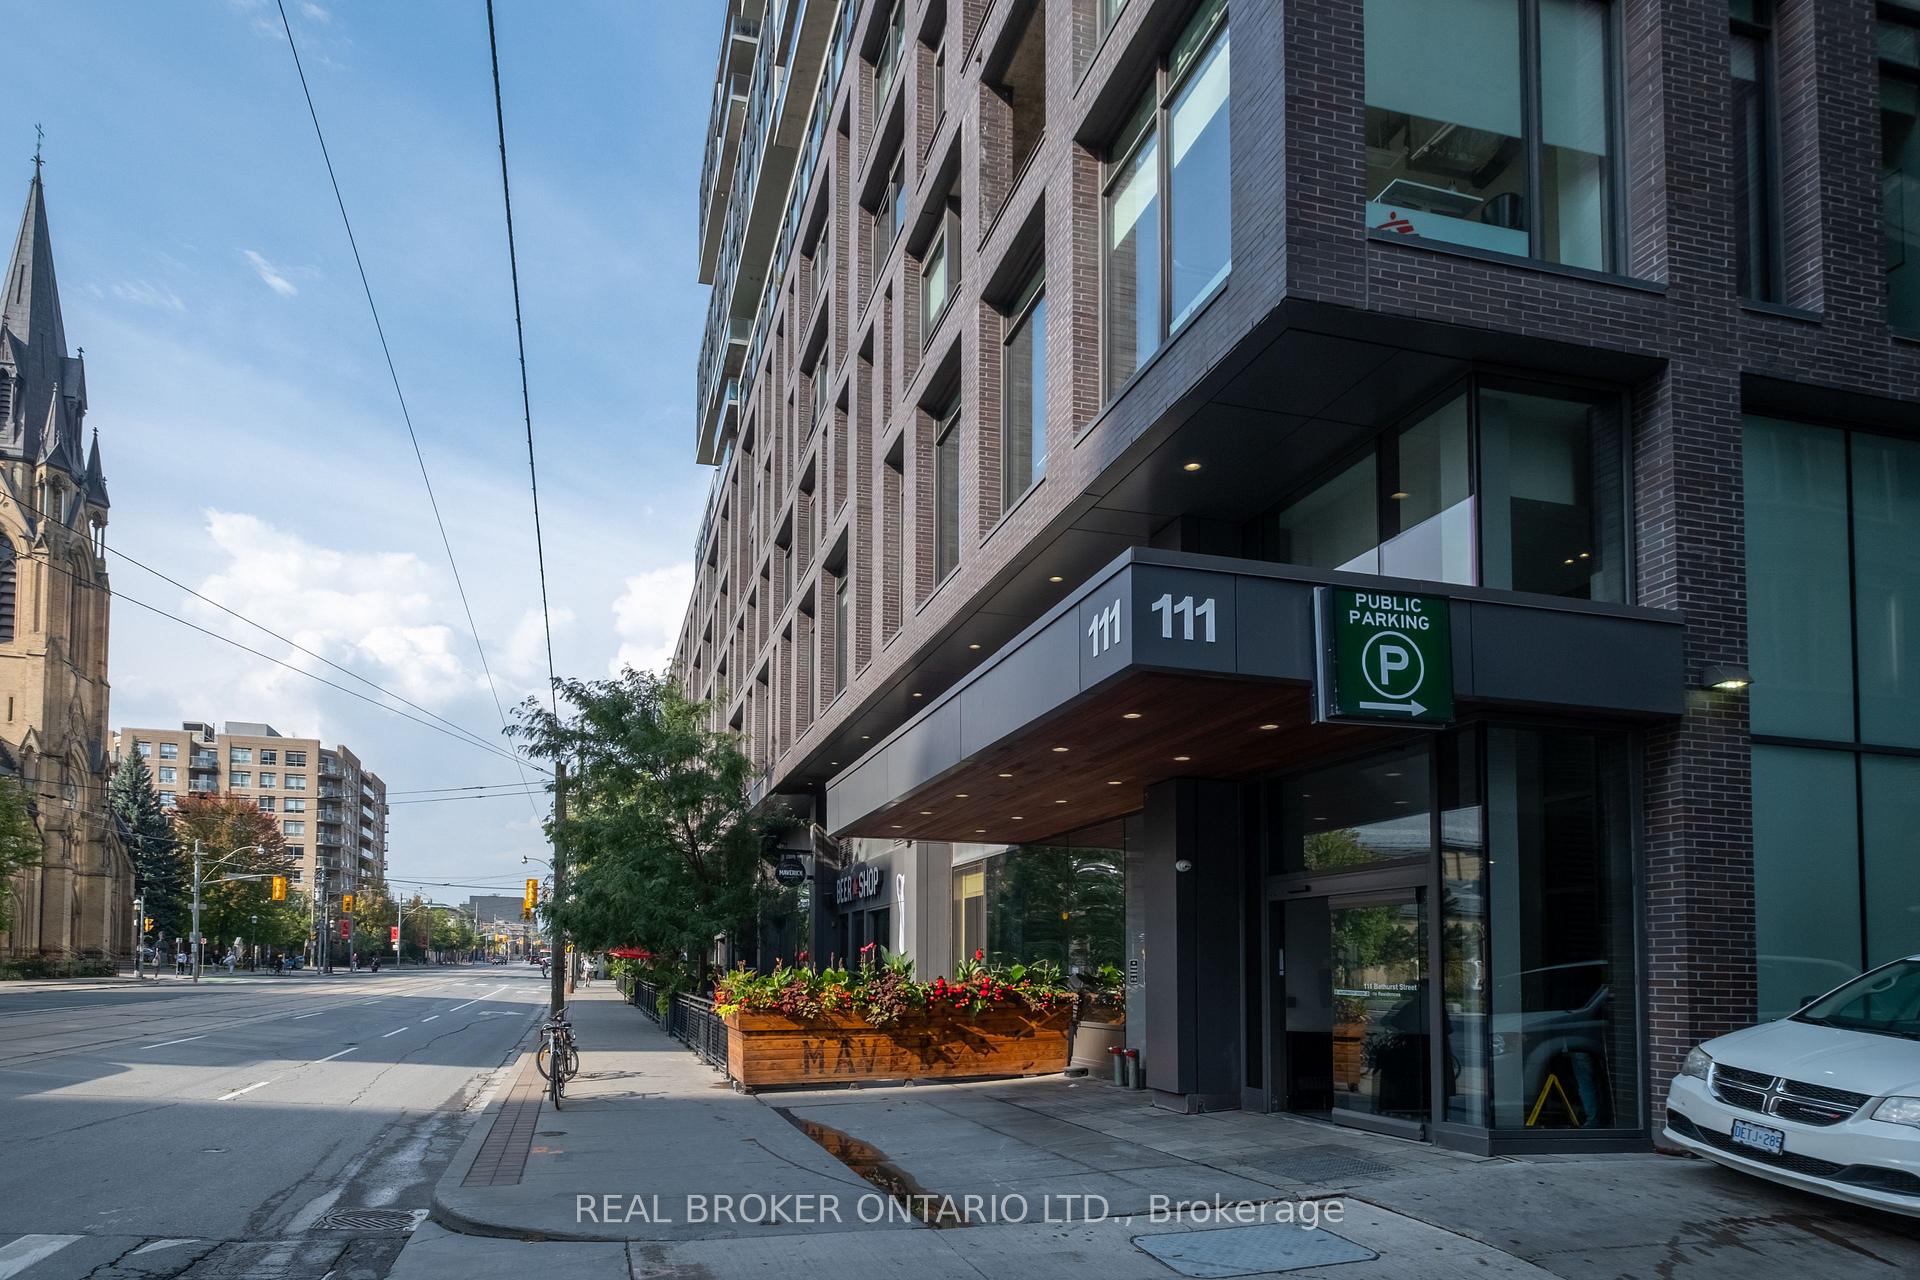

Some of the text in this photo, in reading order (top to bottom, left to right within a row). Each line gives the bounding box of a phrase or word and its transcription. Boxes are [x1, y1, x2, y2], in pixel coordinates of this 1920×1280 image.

[1151, 593, 1216, 643] 111
[1349, 610, 1430, 631] PARKING
[1355, 593, 1422, 613] PUBLIC
[1088, 598, 1121, 658] 111
[1379, 644, 1410, 686] P
[836, 866, 879, 905] BEER SHOP
[1373, 983, 1398, 991] Bathurst
[1399, 983, 1418, 991] Street
